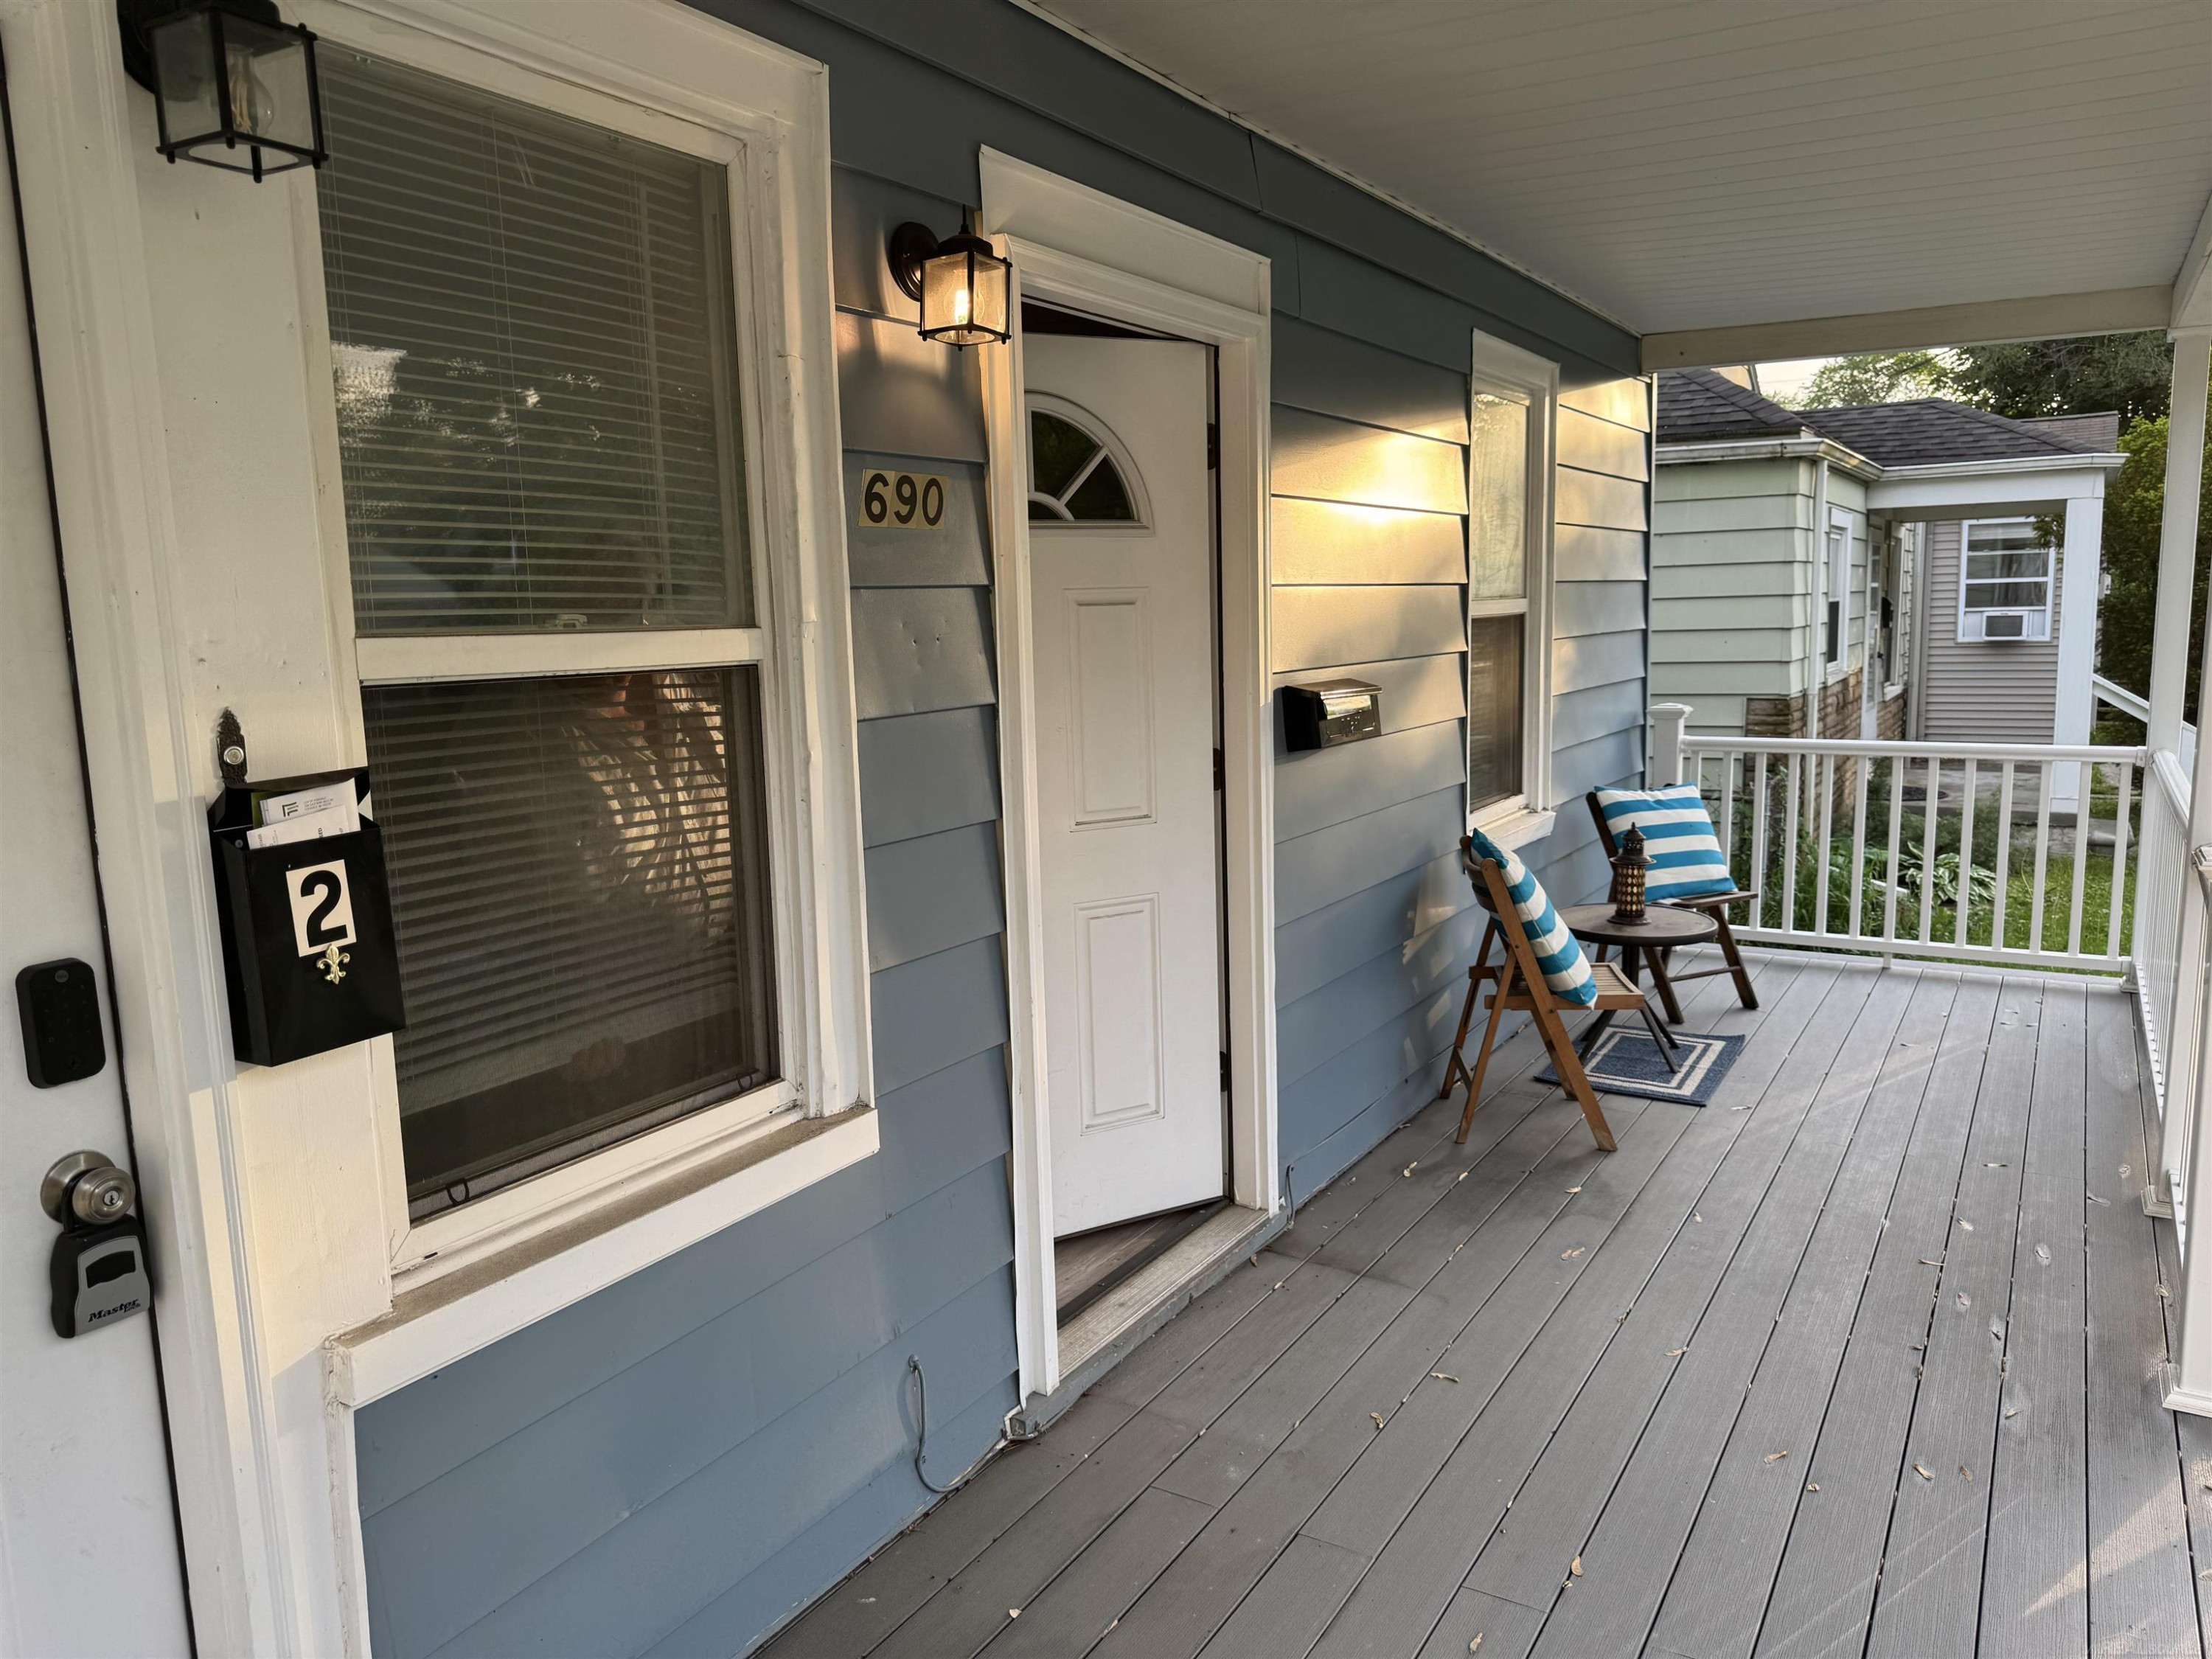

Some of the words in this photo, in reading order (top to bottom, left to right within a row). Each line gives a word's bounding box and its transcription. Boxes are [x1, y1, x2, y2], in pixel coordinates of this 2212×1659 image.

[864, 473, 944, 526] 690
[300, 869, 348, 948] 2
[88, 1298, 139, 1323] Master
